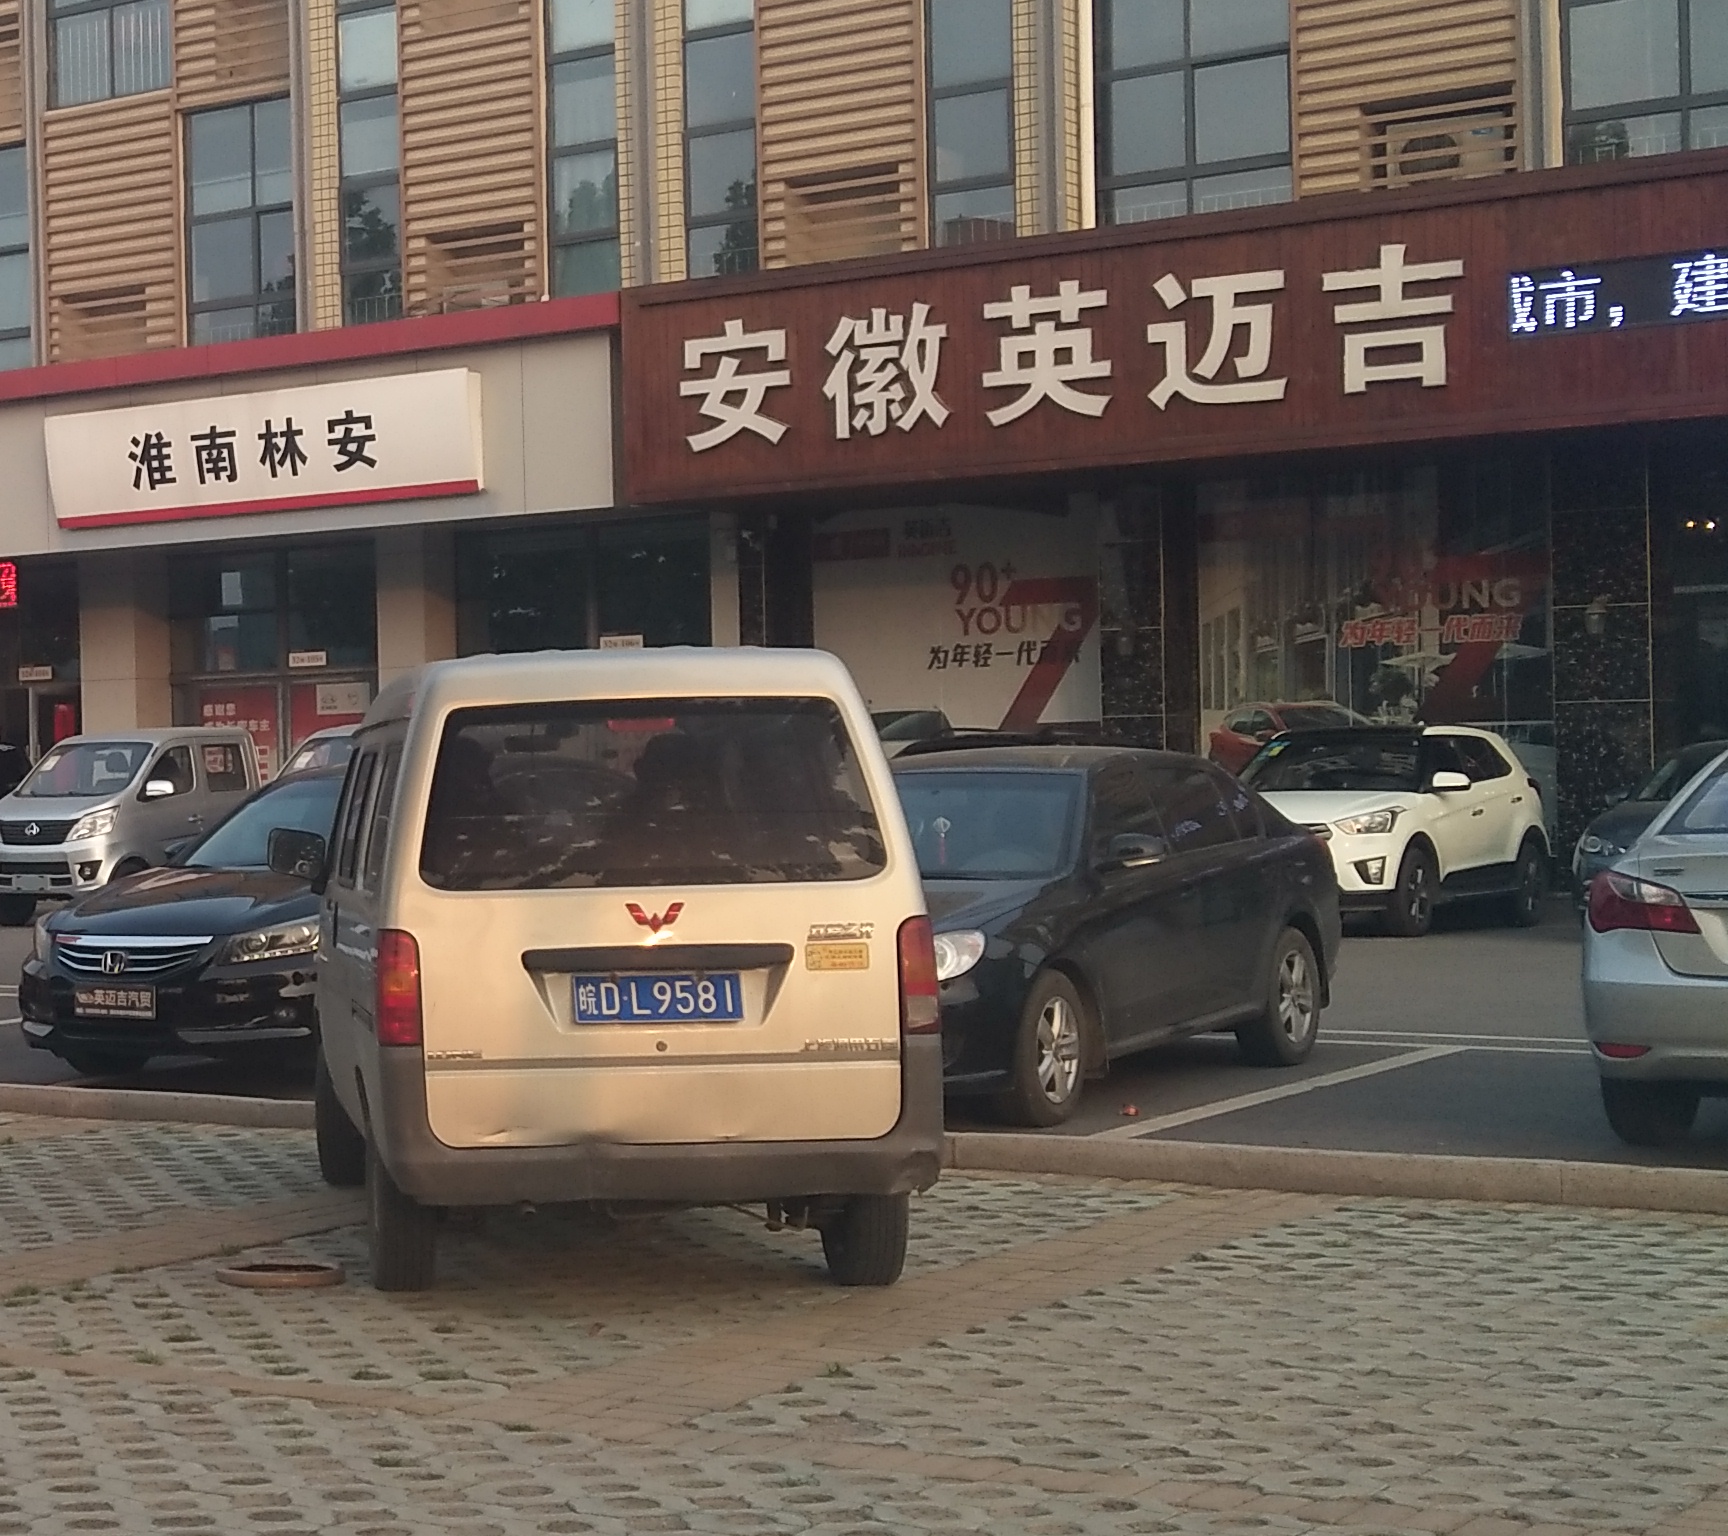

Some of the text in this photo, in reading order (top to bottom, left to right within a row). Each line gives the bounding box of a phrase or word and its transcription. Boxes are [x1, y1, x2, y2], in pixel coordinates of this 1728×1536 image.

[678, 243, 1465, 452] 安徽英迈吉
[128, 410, 379, 491] 淮南林安
[950, 560, 1017, 605] 90+
[927, 639, 1084, 671] 为年轻一代
